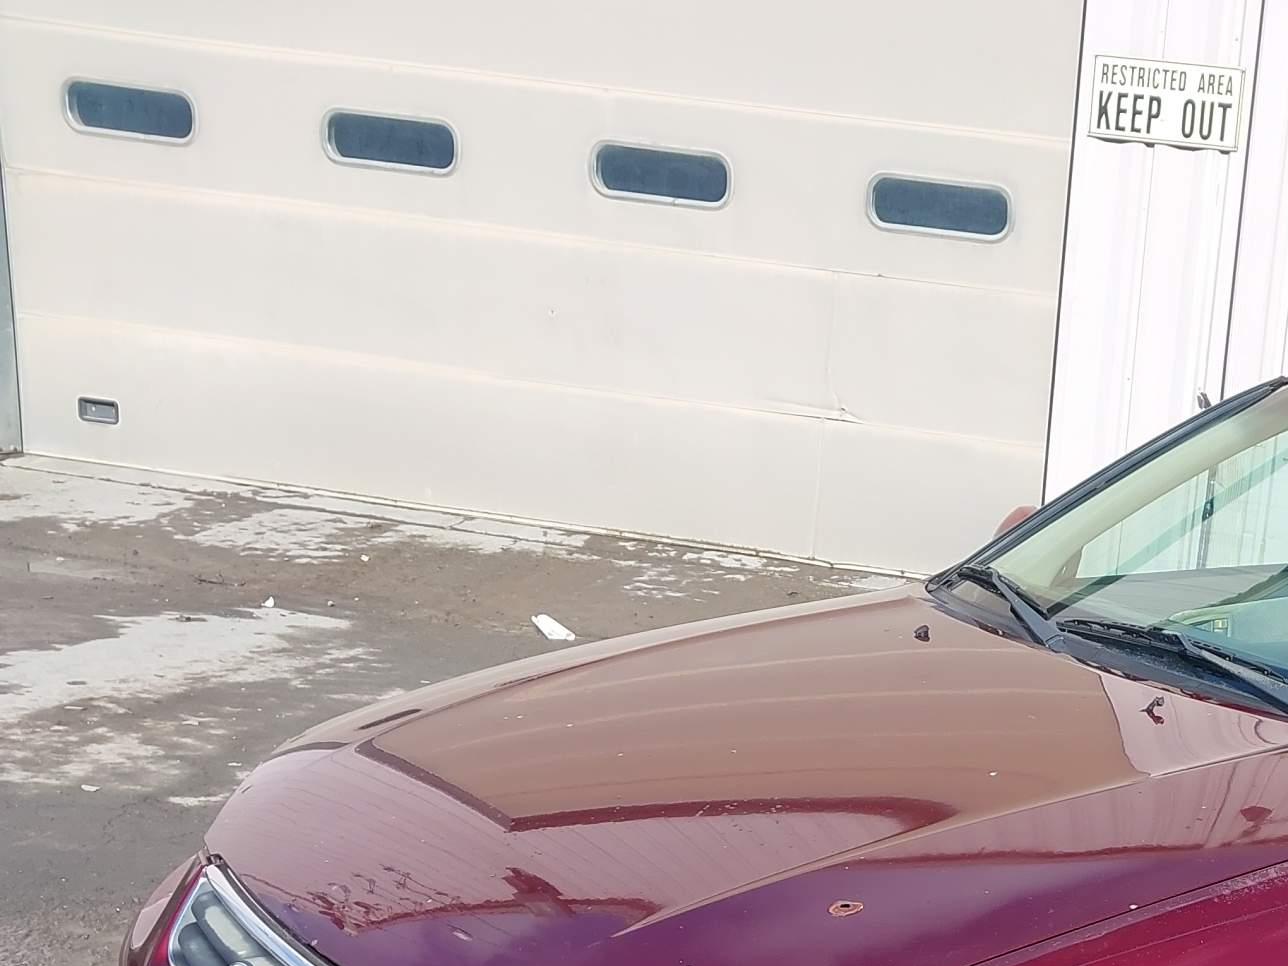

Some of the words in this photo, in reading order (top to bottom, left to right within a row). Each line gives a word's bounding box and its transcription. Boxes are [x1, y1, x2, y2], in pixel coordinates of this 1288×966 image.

[1101, 63, 1187, 91] RESTRICTED
[1197, 72, 1233, 96] AREA
[1097, 90, 1161, 134] KEEP
[1181, 99, 1232, 142] OUT
